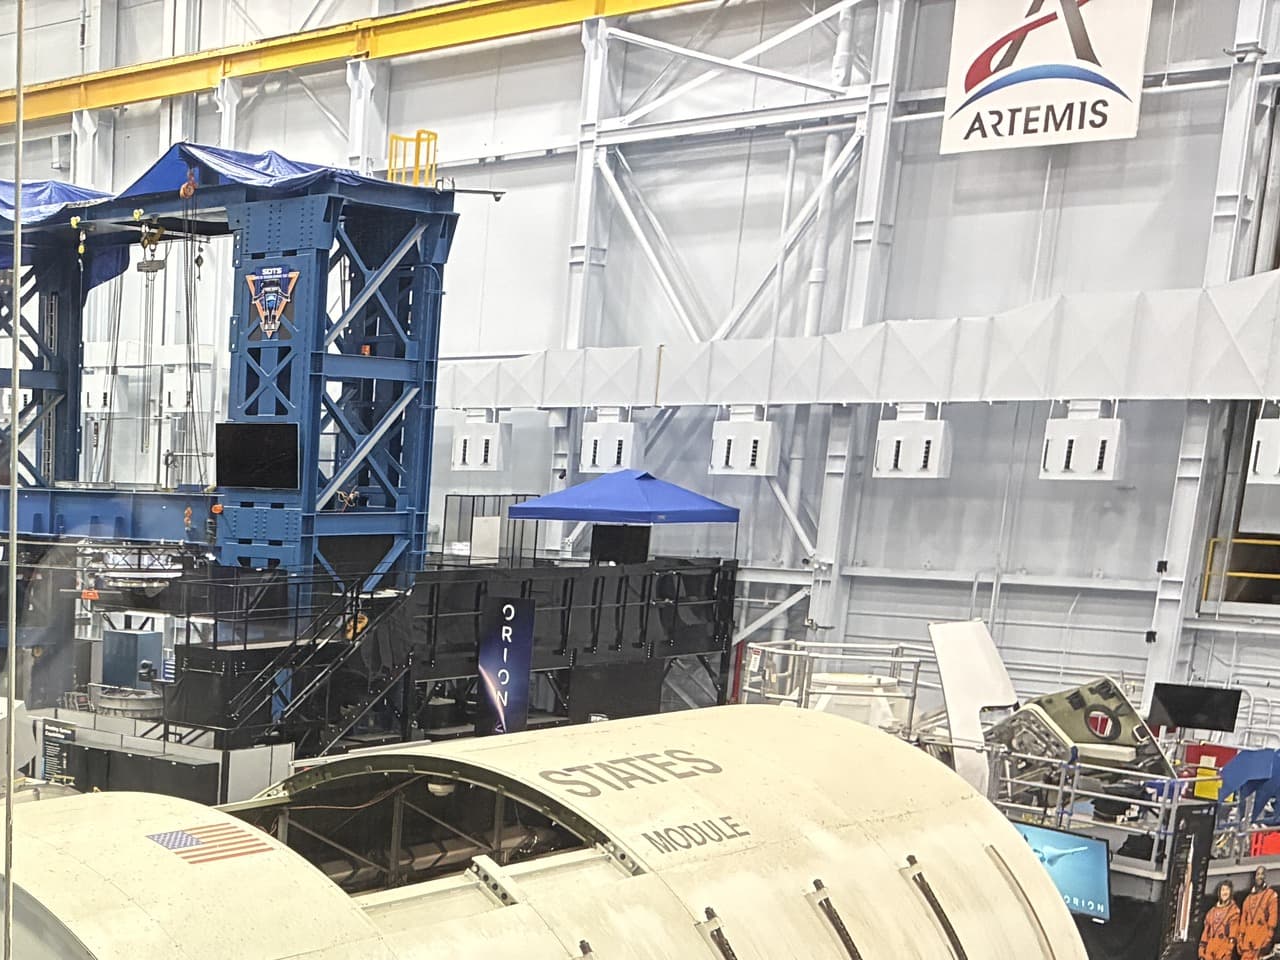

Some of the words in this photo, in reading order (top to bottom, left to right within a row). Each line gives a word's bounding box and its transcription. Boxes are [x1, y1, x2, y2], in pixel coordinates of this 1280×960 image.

[963, 100, 1109, 140] ARTEMIS
[496, 604, 515, 707] ORION
[538, 749, 723, 798] STATES
[641, 816, 751, 854] MODULE
